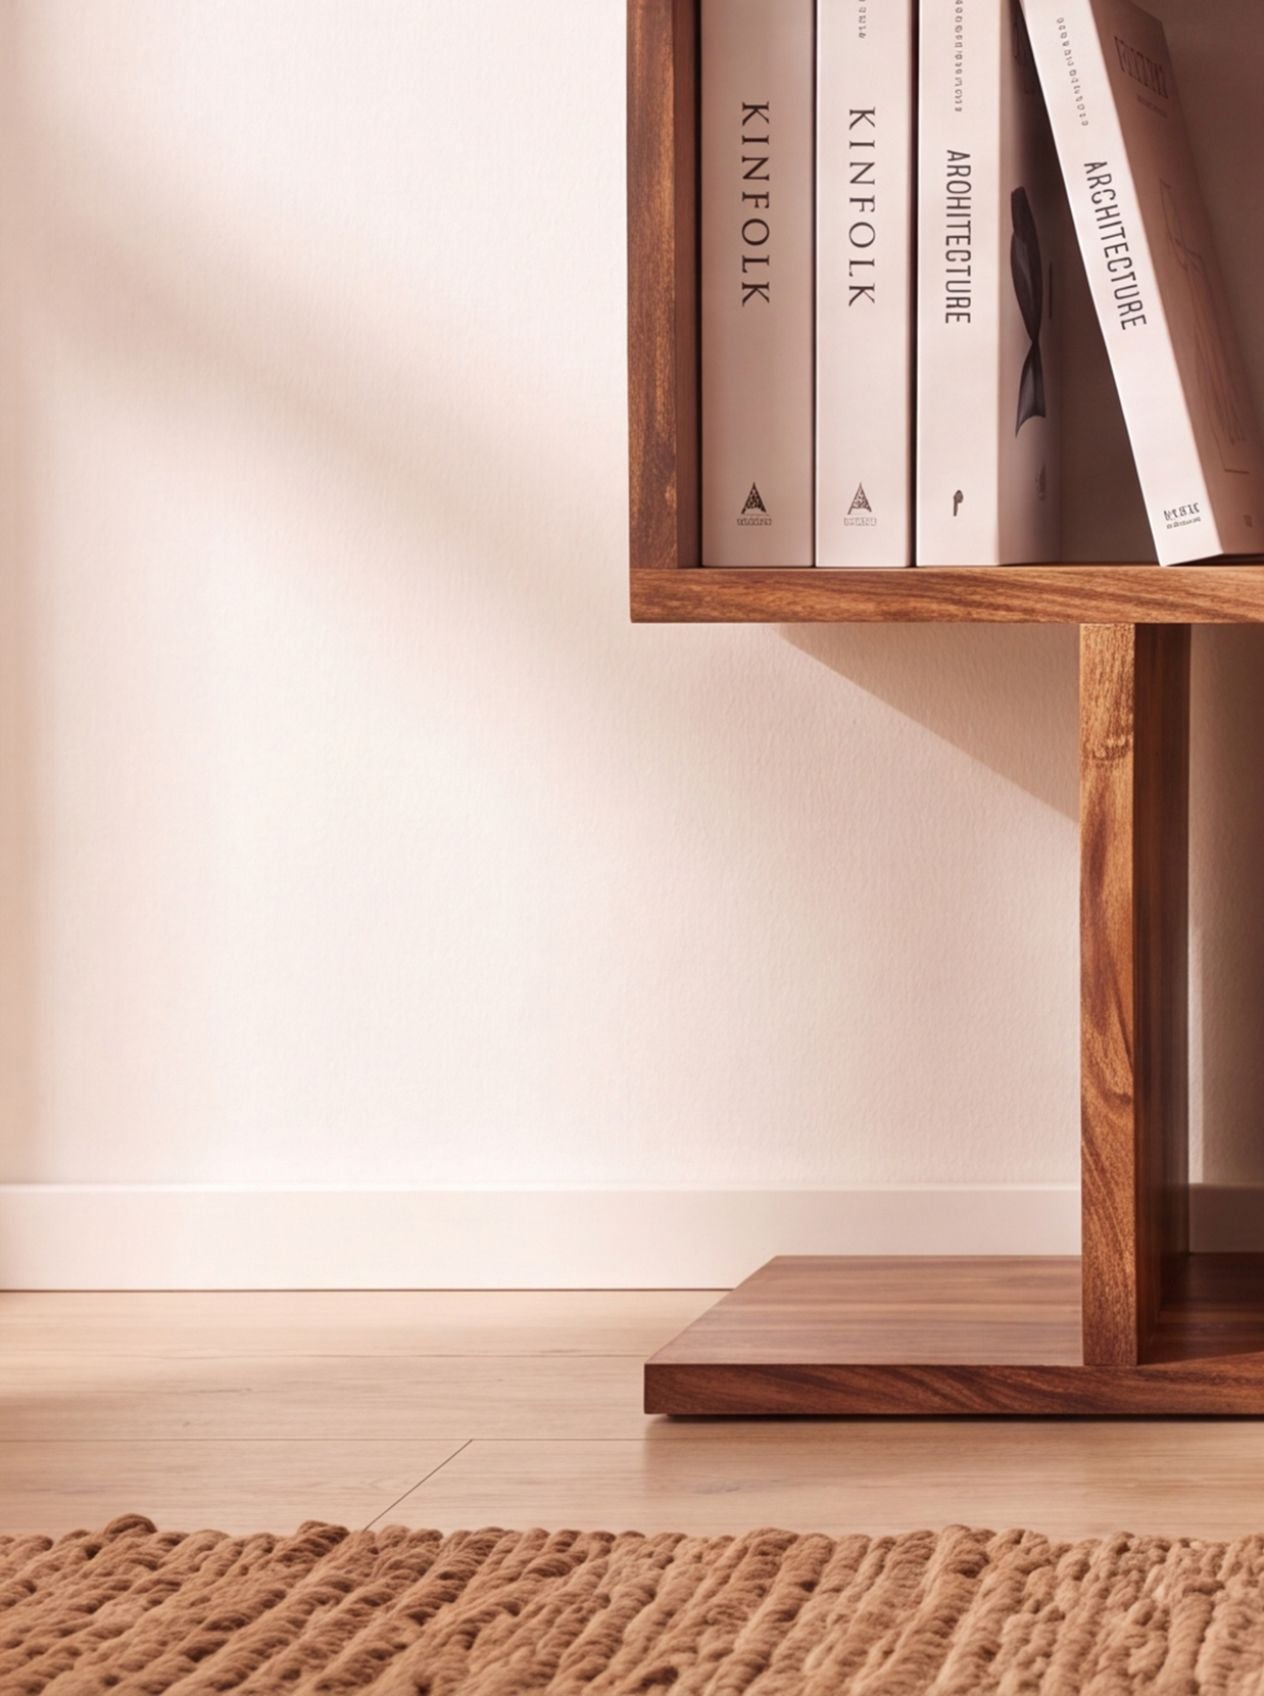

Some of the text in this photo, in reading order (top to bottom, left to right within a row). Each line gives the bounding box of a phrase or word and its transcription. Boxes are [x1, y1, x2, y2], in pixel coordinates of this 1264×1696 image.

[741, 101, 770, 307] KINFOLK
[847, 106, 876, 307] KINFOLK
[1083, 160, 1147, 331] ARCHITECTURE
